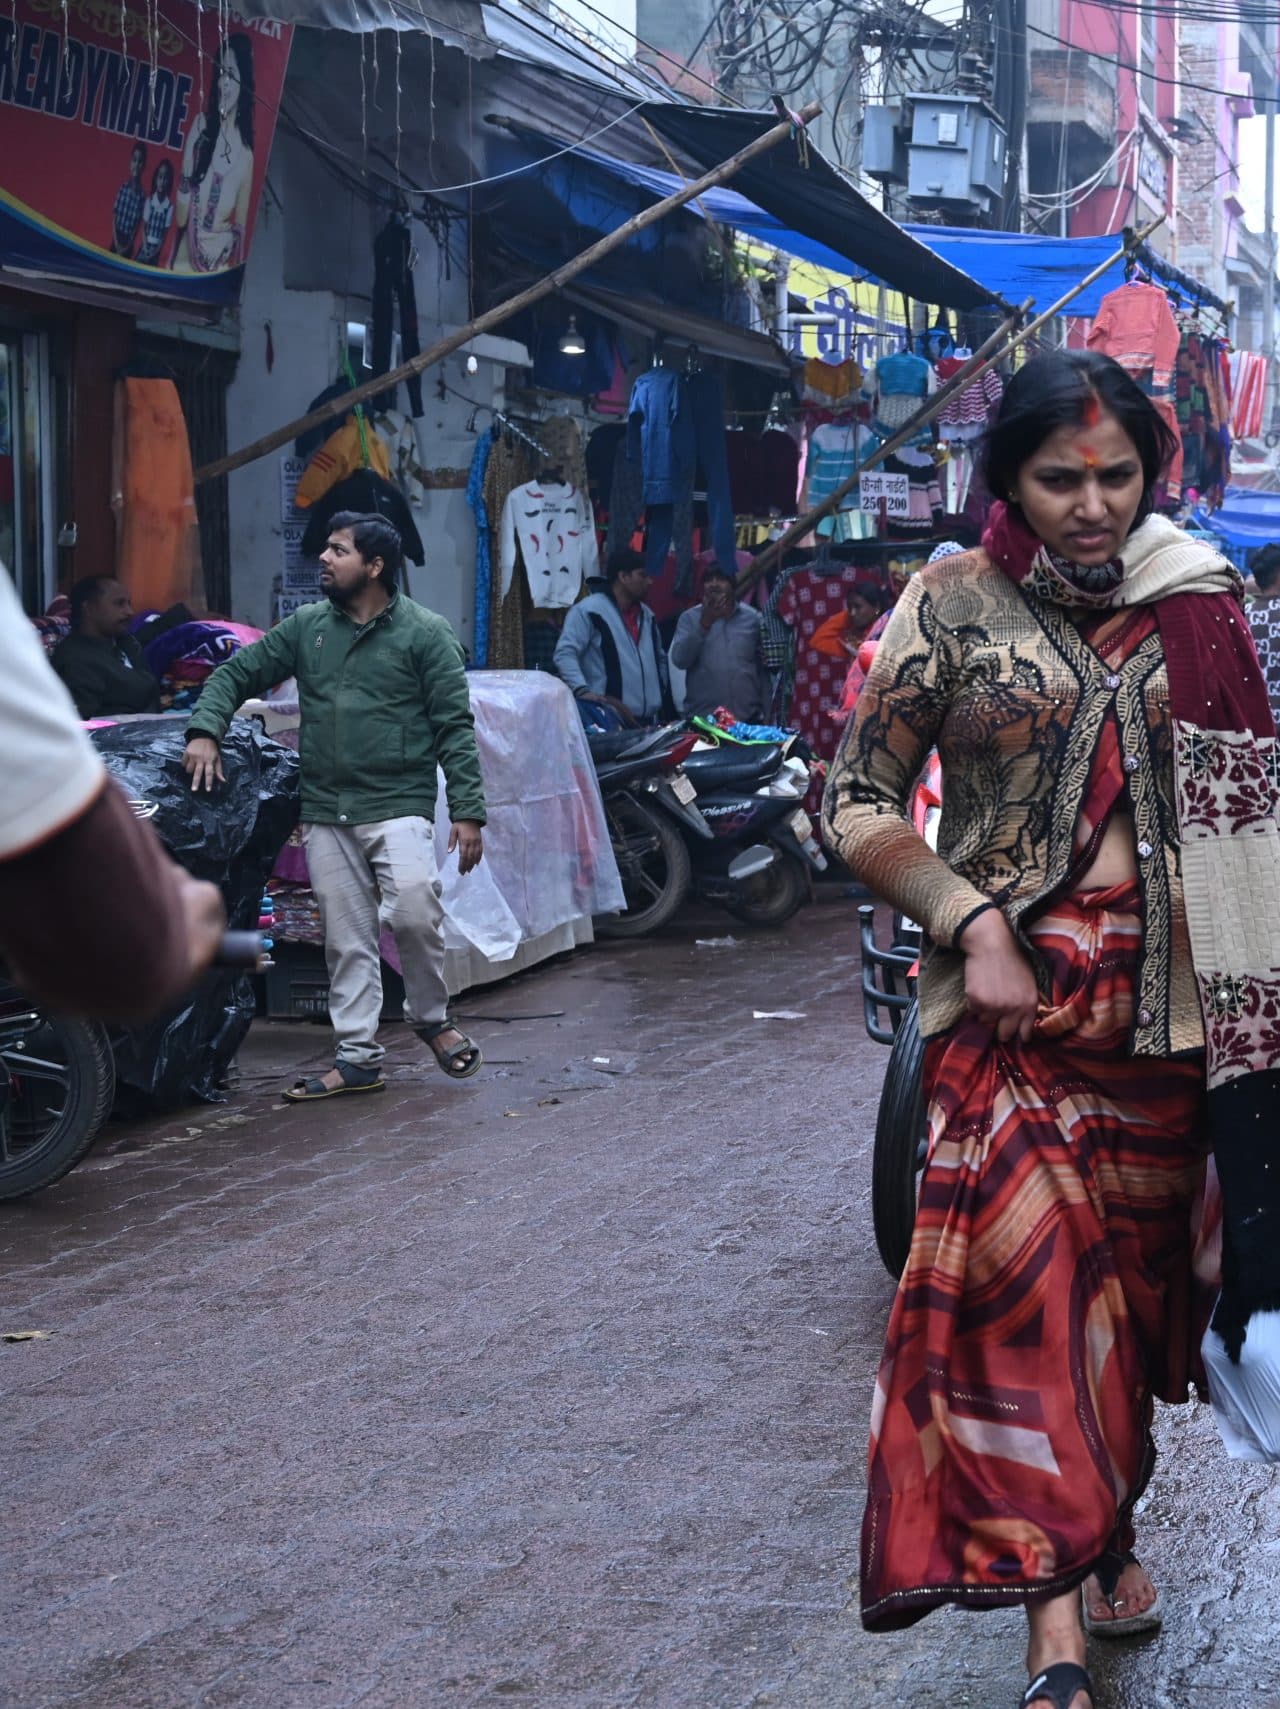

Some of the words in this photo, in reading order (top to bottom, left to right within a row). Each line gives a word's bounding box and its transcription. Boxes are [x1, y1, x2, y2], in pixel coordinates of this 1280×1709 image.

[0, 15, 194, 152] READYMADE
[887, 497, 907, 511] 200
[701, 801, 752, 816] Pleasure
